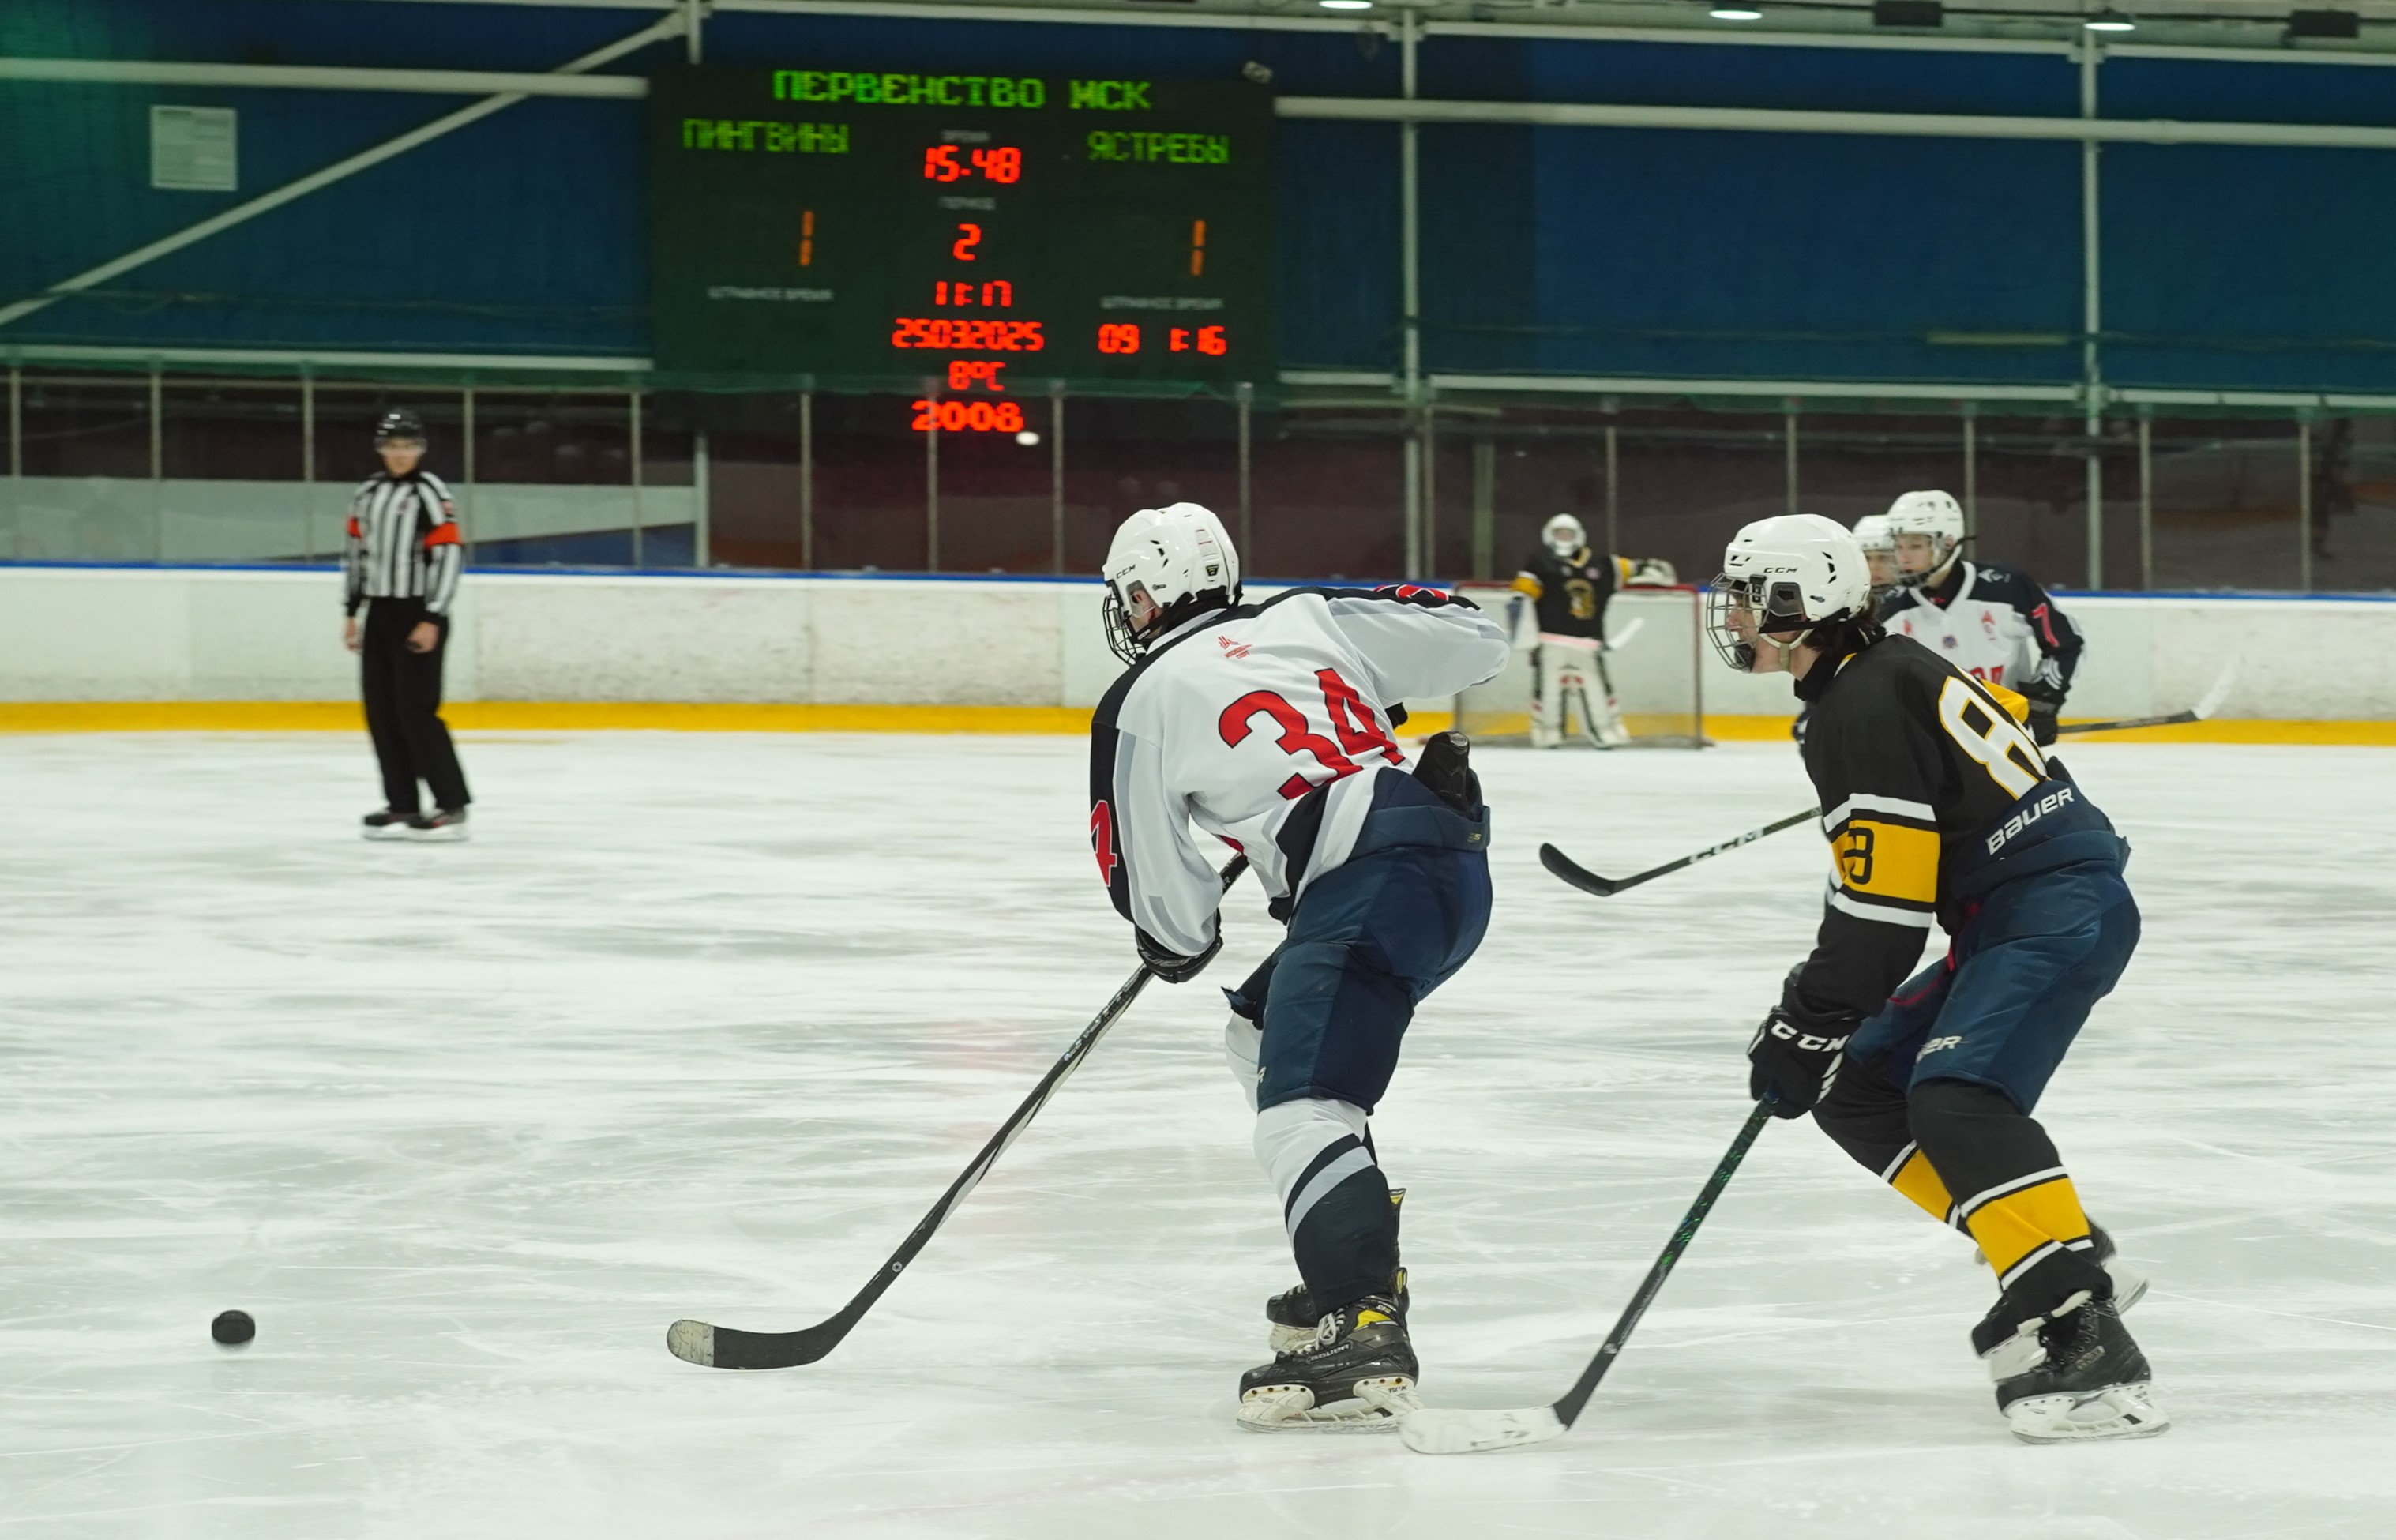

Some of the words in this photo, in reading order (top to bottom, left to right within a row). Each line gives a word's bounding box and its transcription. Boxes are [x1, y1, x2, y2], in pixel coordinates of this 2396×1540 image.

[772, 69, 1046, 108] ПЕРВЕНСТВО
[1069, 80, 1151, 110] МСК
[683, 119, 850, 153] ПИНГВИНЫ
[1087, 131, 1230, 164] ЯСТРЕБЫ
[799, 211, 813, 266] 1
[952, 223, 982, 261] 2
[1191, 220, 1206, 276] 1
[891, 317, 1046, 351] 25032025
[1098, 323, 1140, 355] 09
[911, 400, 1025, 433] 2008
[2030, 603, 2060, 648] 7
[1218, 667, 1406, 801] 34
[1771, 1019, 1850, 1052] CCM
